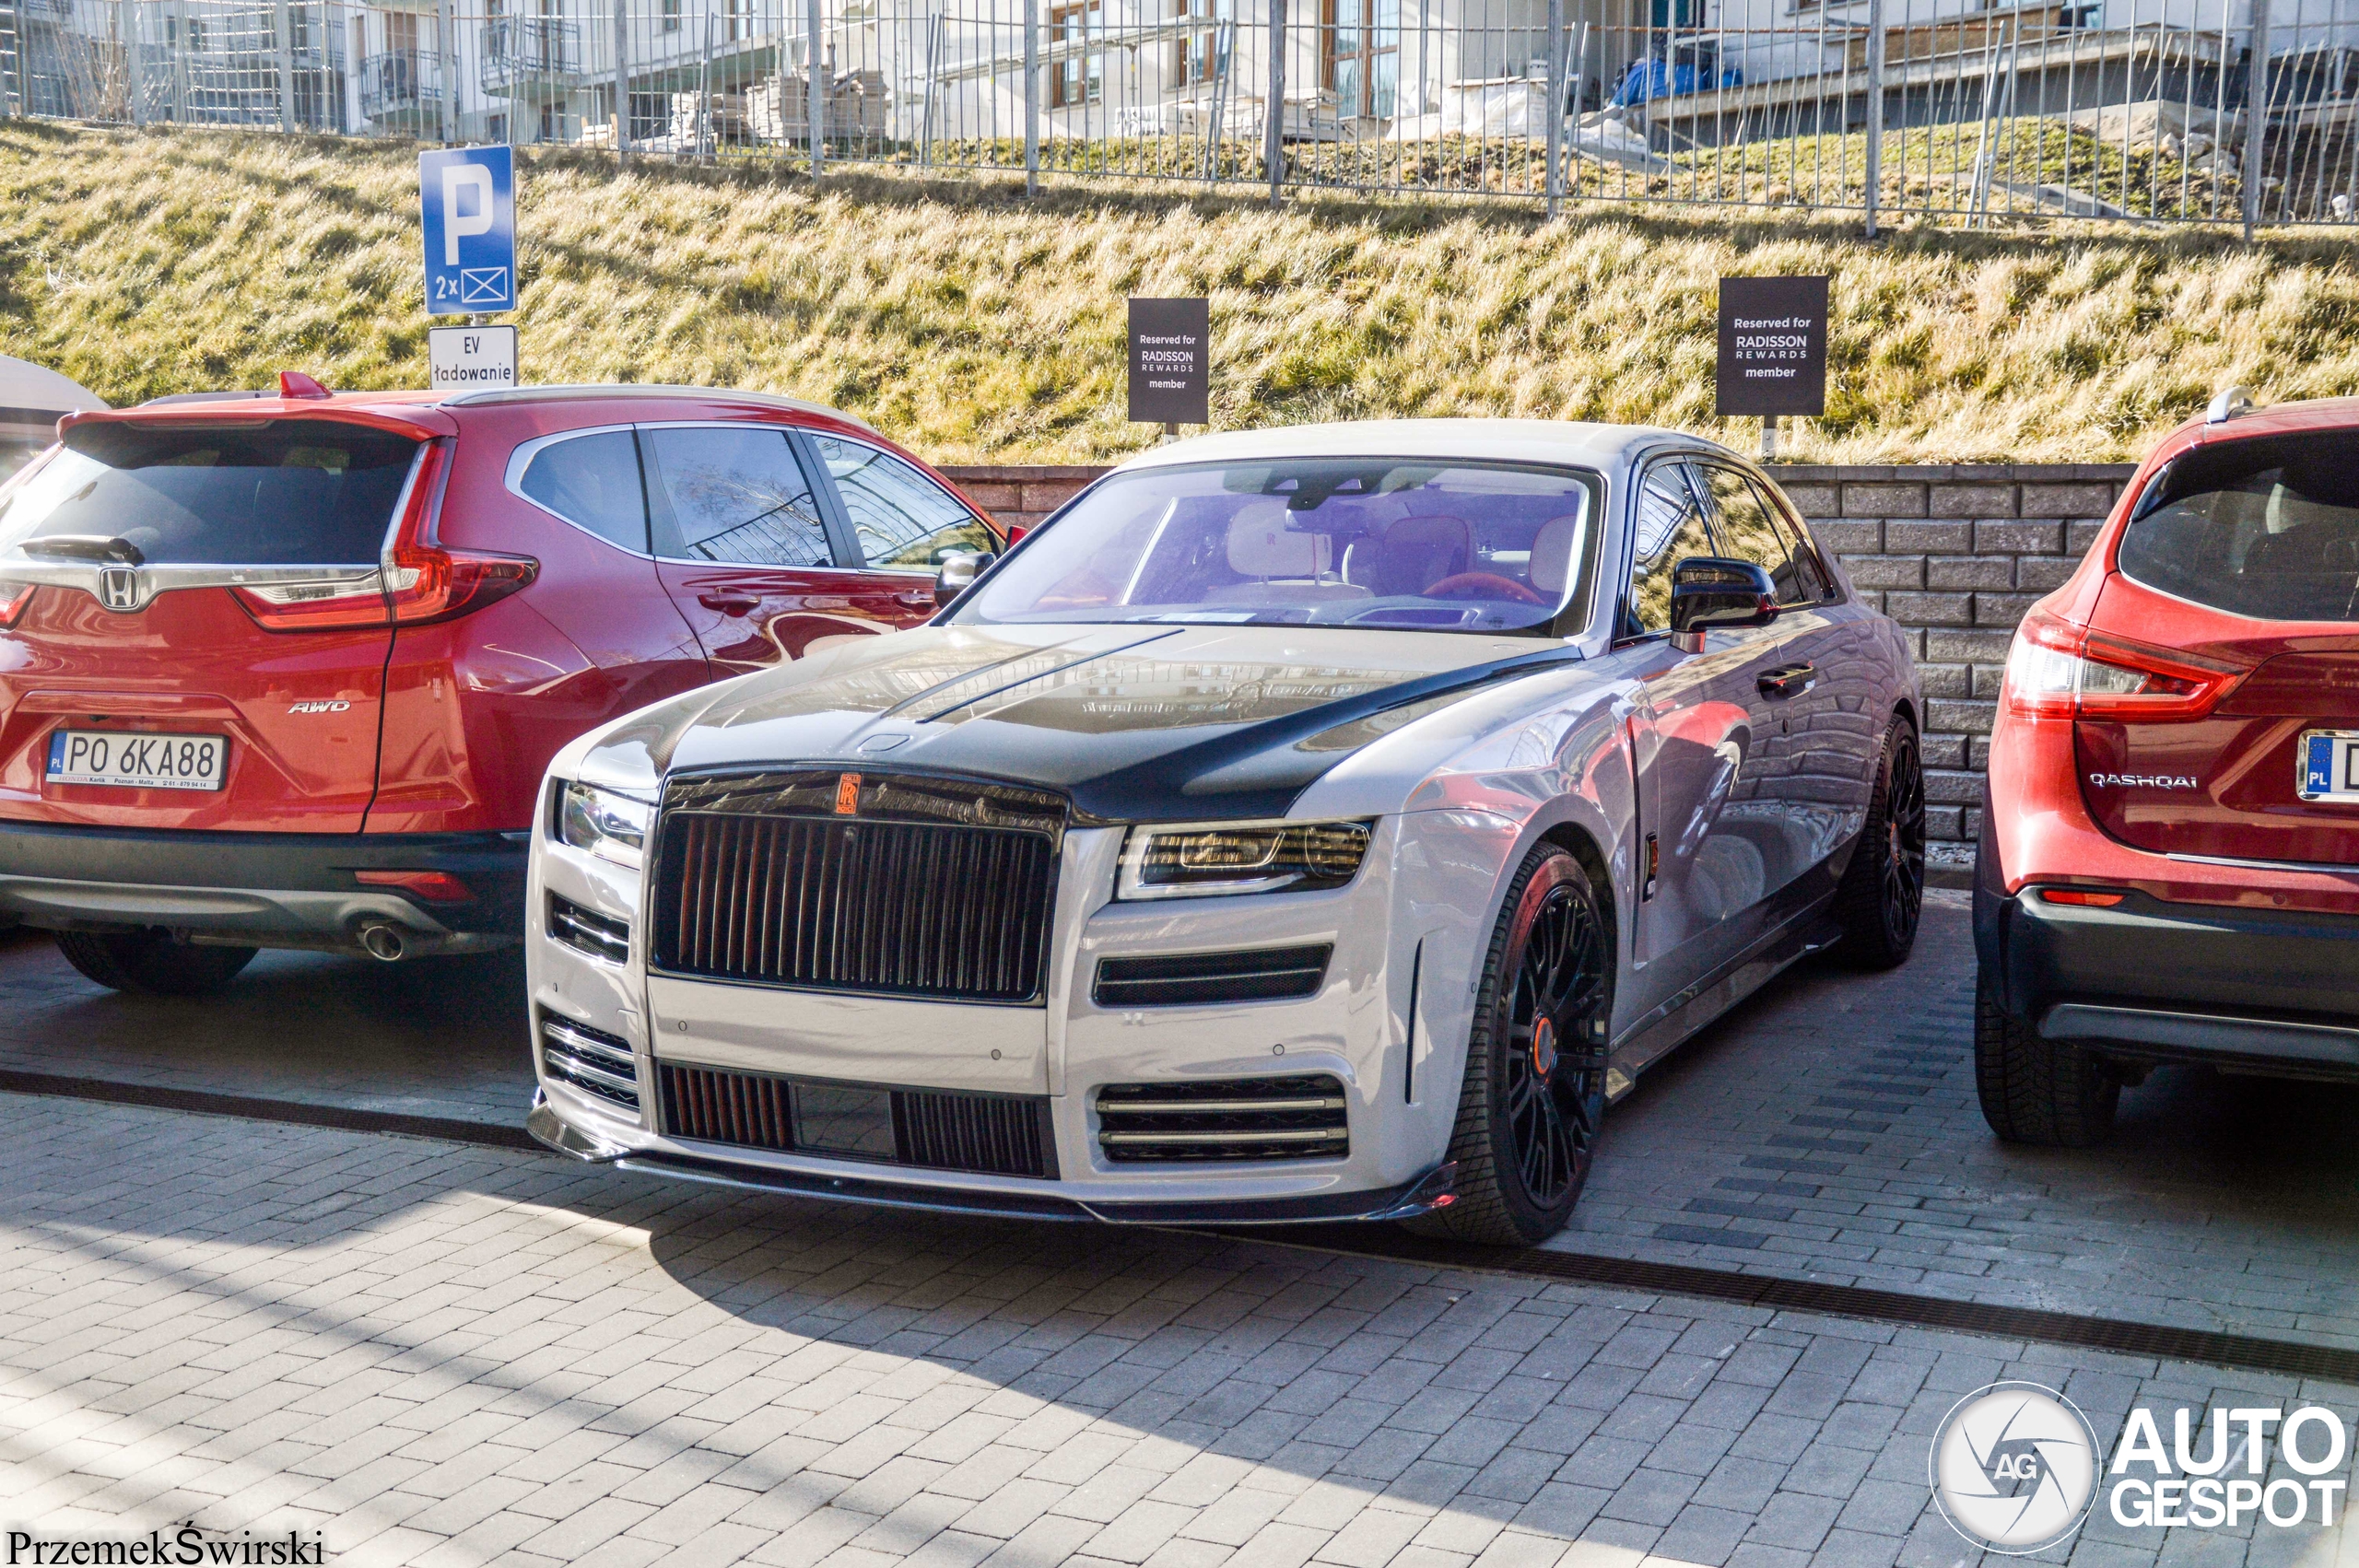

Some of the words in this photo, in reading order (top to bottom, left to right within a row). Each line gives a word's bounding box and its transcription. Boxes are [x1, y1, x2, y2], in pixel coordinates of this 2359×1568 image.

[441, 163, 494, 266] P
[436, 275, 459, 299] 2x
[1734, 318, 1790, 329] Reserved
[1793, 317, 1812, 328] for
[464, 336, 480, 355] EV
[1140, 334, 1180, 345] Reserved
[1182, 335, 1196, 345] for
[1736, 335, 1807, 348] RADISSON
[1142, 351, 1193, 362] RADISSON
[1735, 350, 1807, 359] REWARDS
[434, 362, 511, 382] ładowanie
[1142, 364, 1193, 372] REWARDS
[1745, 368, 1796, 378] member
[1149, 380, 1186, 389] member
[287, 700, 350, 714] AWD
[52, 758, 62, 768] PL
[69, 737, 109, 772] PO
[120, 739, 214, 778] 6KA88
[2089, 773, 2197, 789] QASHQAI
[2309, 772, 2328, 786] PL
